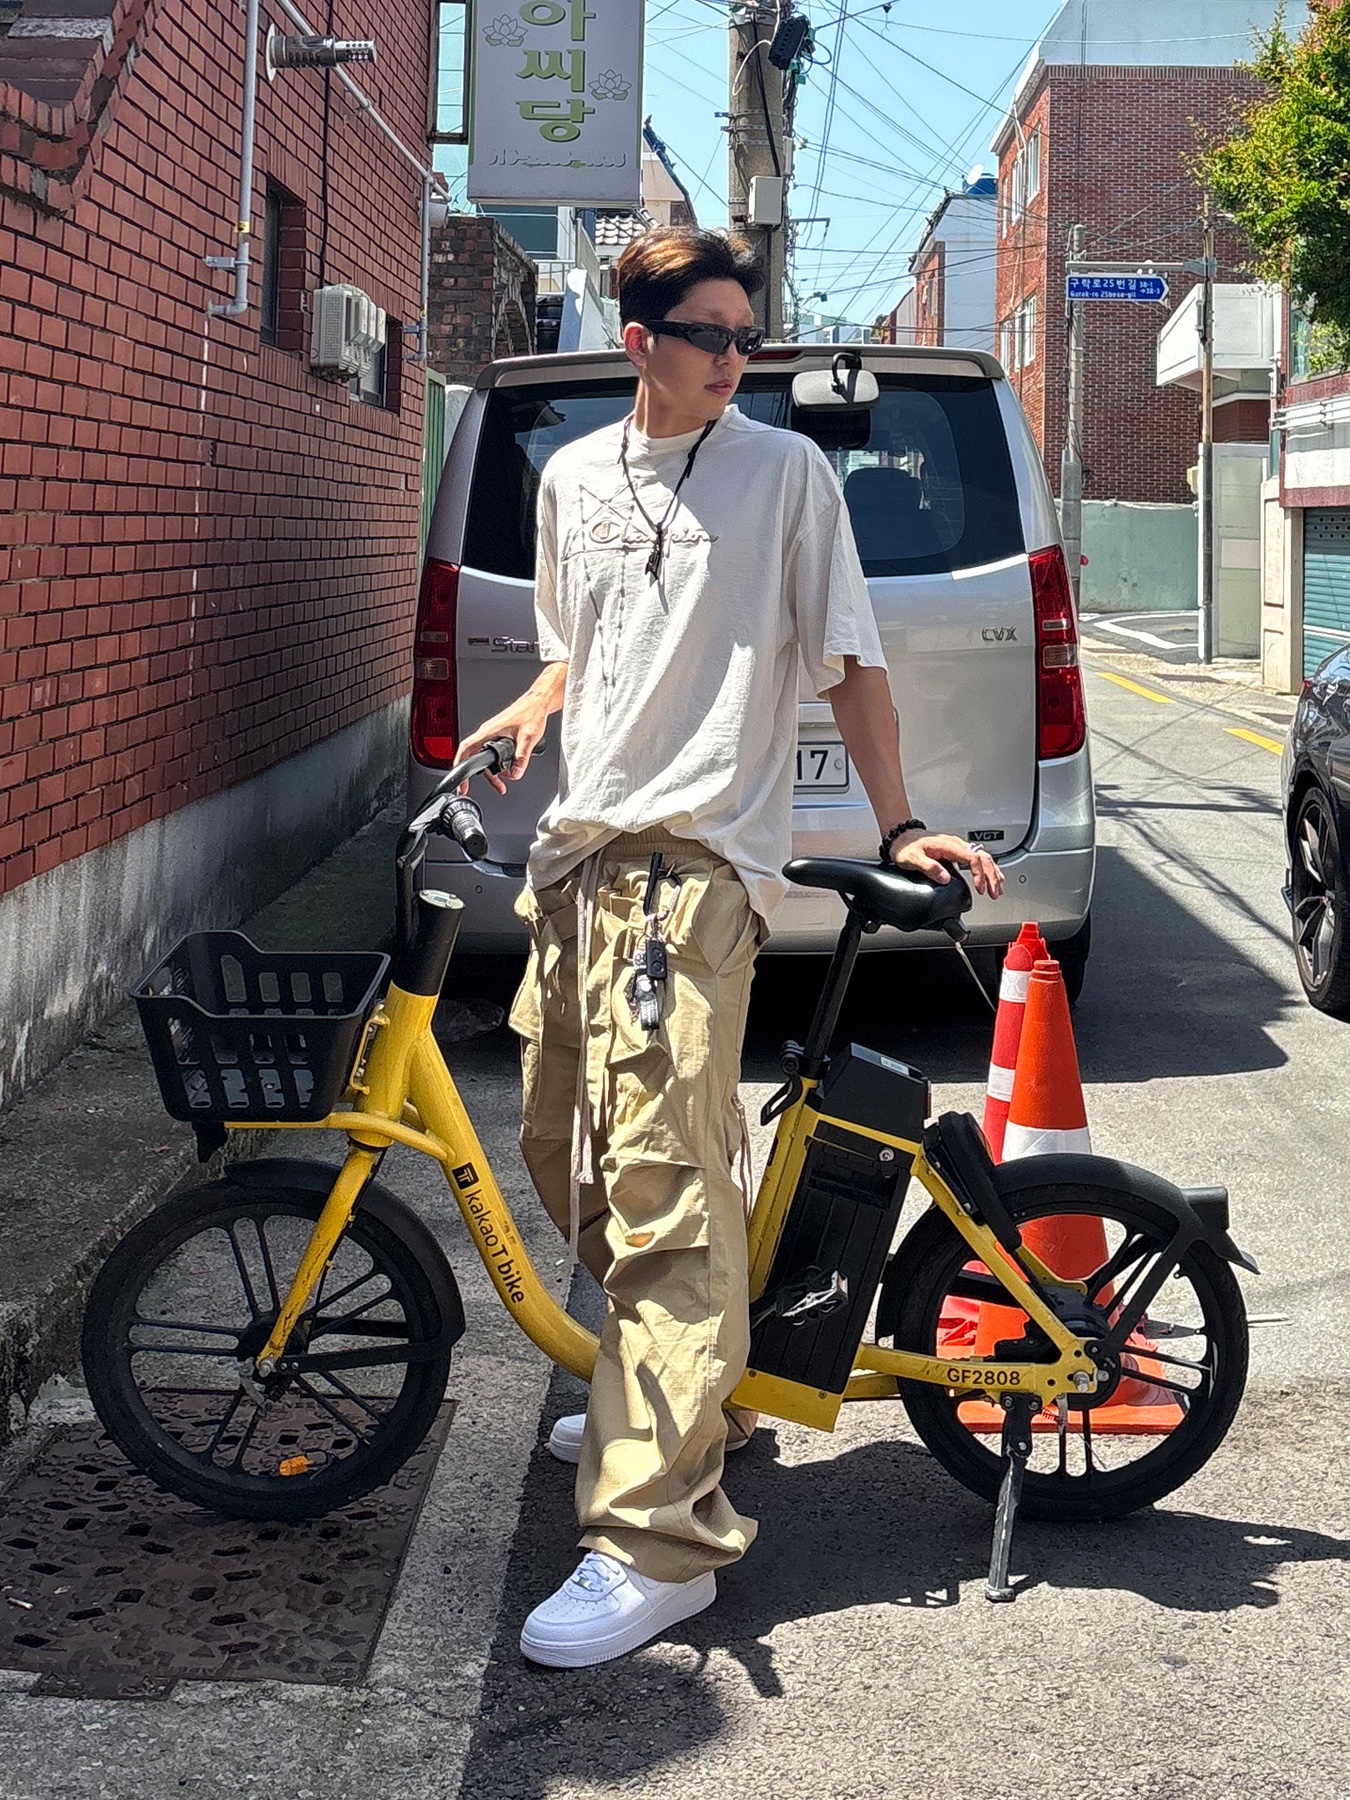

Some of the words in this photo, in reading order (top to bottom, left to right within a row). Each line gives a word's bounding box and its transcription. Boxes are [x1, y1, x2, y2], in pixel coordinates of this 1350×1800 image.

[516, 0, 597, 143] 아씨당
[981, 625, 1018, 642] CVX
[974, 831, 1000, 841] VGT
[465, 1188, 499, 1247] kakao
[497, 1259, 525, 1304] bike
[947, 1368, 1021, 1386] GF2808
